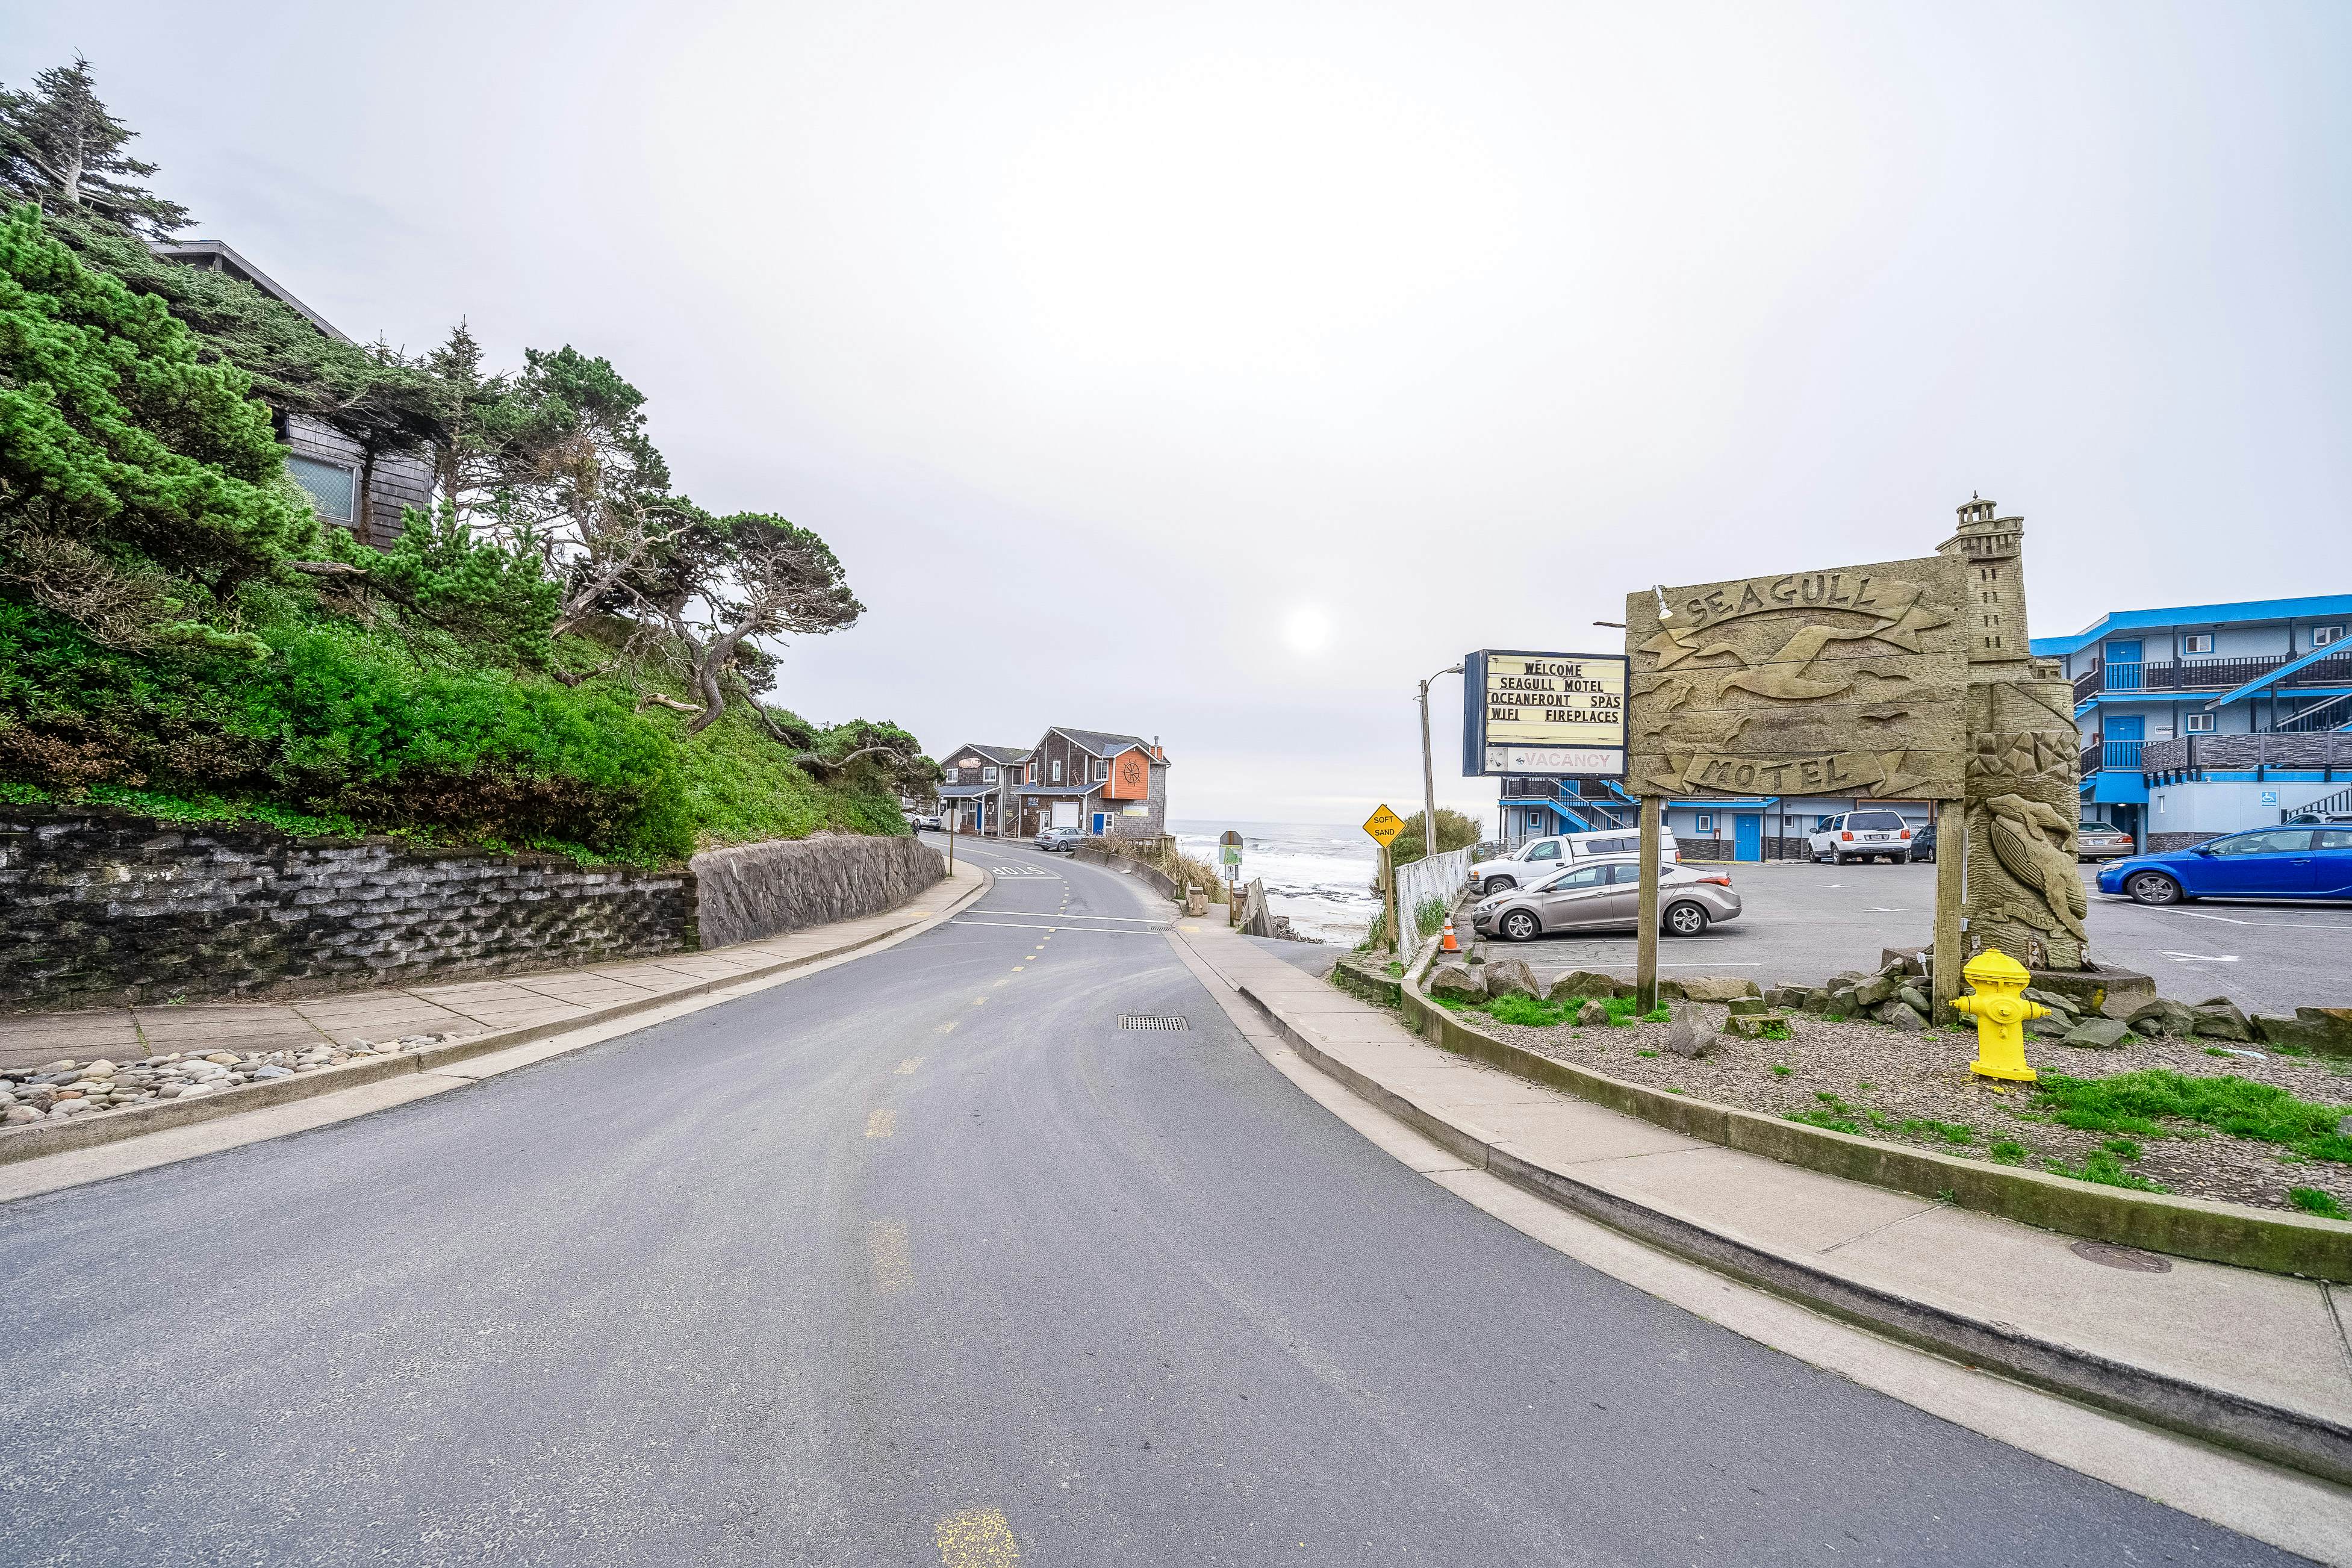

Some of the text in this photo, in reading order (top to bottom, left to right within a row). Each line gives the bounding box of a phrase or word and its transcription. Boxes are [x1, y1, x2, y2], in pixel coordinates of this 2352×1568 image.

[1687, 574, 1876, 627] SEAGULL
[1525, 663, 1581, 676] WELCOME
[1501, 678, 1604, 692] SEAGULL MOTEL
[1491, 693, 1620, 708] OCEANFRONT SPAS
[1492, 708, 1619, 723] WIFI FIREPLACES
[1525, 753, 1610, 767] VACANCY
[1700, 758, 1847, 792] MOTEL
[992, 866, 1045, 875] STOP
